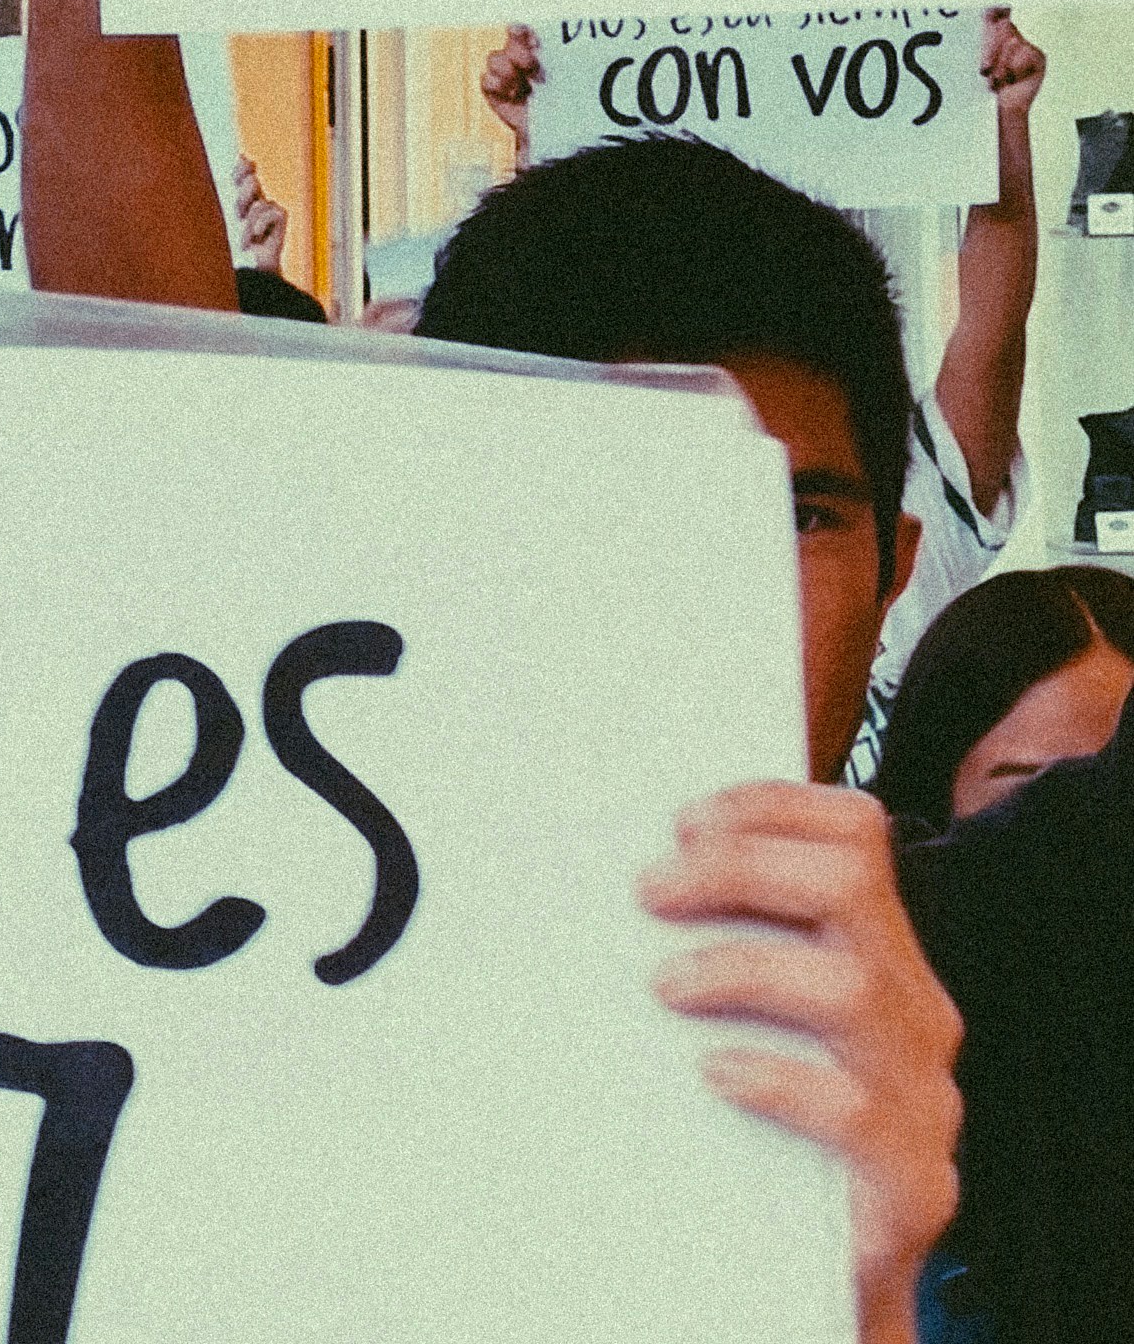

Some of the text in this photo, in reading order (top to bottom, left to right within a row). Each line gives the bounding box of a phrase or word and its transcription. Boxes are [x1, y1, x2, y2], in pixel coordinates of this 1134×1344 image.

[598, 30, 944, 127] con vos
[68, 619, 421, 987] es
